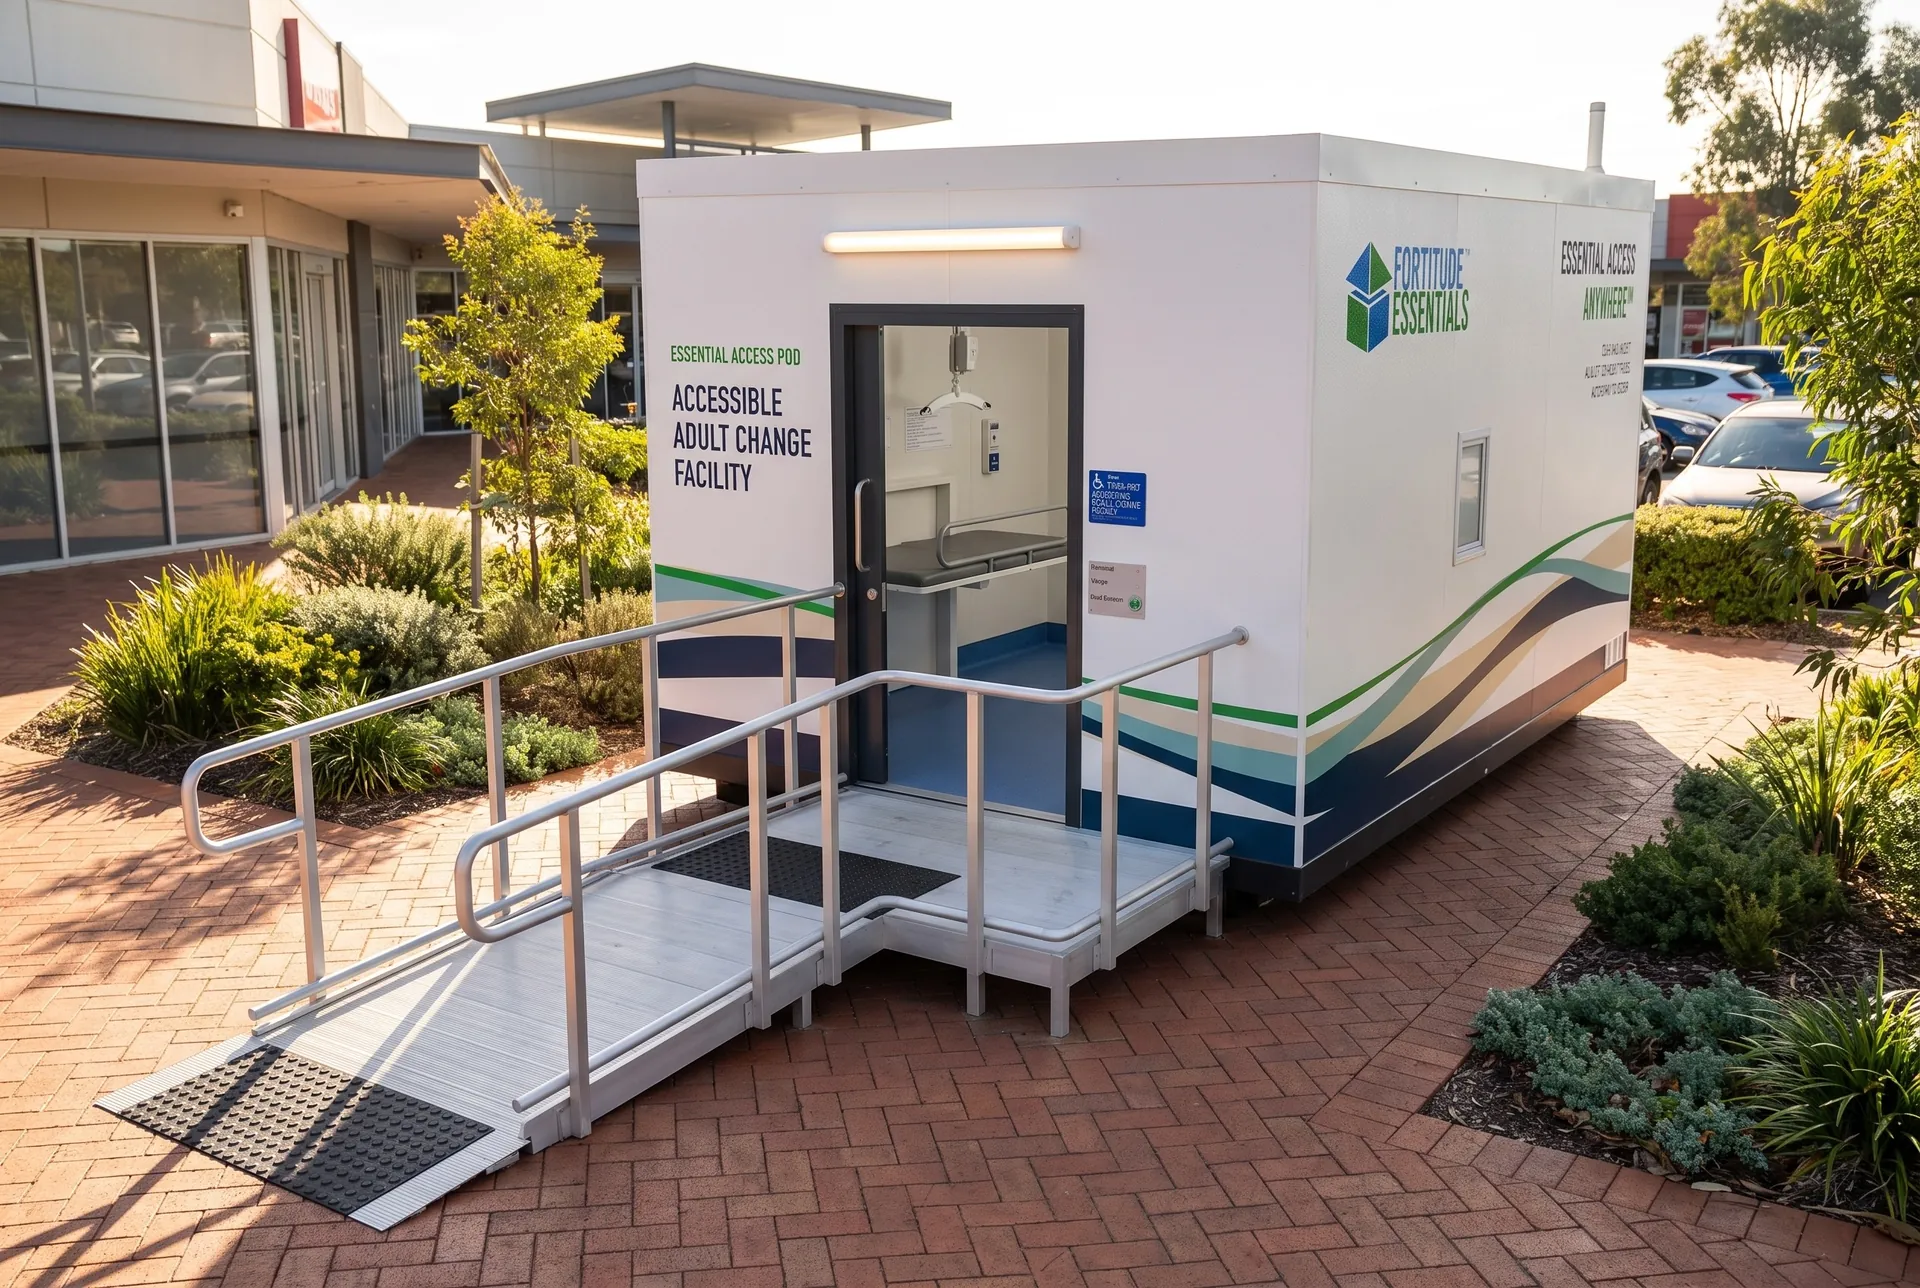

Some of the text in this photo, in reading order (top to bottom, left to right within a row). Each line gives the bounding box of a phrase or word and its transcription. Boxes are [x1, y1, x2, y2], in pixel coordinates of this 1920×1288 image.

[1561, 240, 1636, 275] ESSENTIAL ACCESS
[1392, 289, 1469, 335] ESSENTIALS
[670, 345, 801, 366] ESSENTIAL ACCESS POD
[672, 384, 783, 416] ACCESSIBLE
[673, 421, 812, 458] ADULT CHANGE
[674, 458, 752, 492] FACILITY
